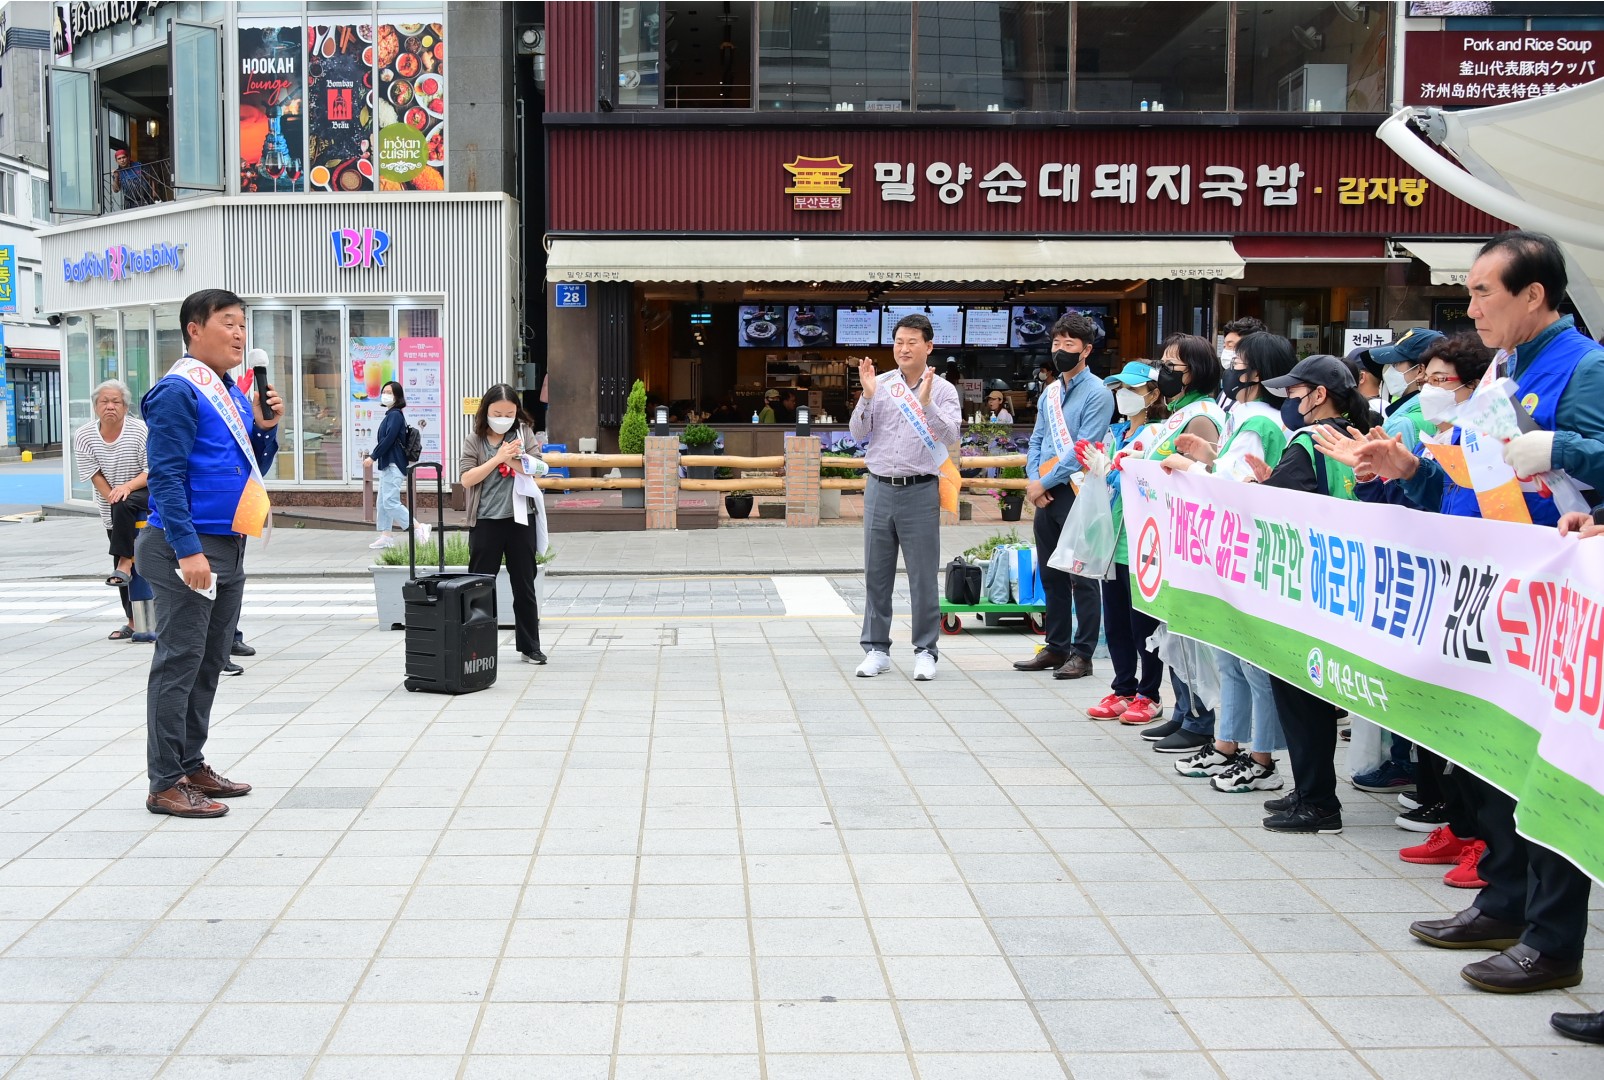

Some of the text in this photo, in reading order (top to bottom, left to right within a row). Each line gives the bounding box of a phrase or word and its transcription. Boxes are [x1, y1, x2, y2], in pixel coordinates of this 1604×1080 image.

[1463, 37, 1592, 54] Pork and Rice Soup
[242, 57, 294, 74] HOOKAH
[1459, 60, 1596, 76] 釜山代表豚肉クッパ
[243, 70, 292, 106] Lounge
[326, 80, 354, 88] Bombay
[332, 121, 349, 129] Bräu
[383, 135, 421, 149] indian
[379, 149, 421, 160] cuisine
[874, 162, 1305, 206] 밀양순대돼지국밥
[1337, 177, 1428, 207] 감자탕
[794, 196, 842, 209] 부산본점
[331, 227, 391, 267] BR
[63, 251, 105, 283] baskin
[129, 242, 180, 274] robbins
[567, 271, 620, 279] 밀양돼지국밥
[868, 271, 921, 279] 밀양돼지국밥
[563, 292, 579, 302] 28
[1352, 333, 1384, 346] 전메뉴
[1216, 509, 1250, 584] 없는
[1254, 518, 1304, 601] 쾌적한
[1308, 527, 1366, 623] 해운대
[1443, 564, 1499, 665] 위한
[1327, 658, 1389, 712] 해운대구
